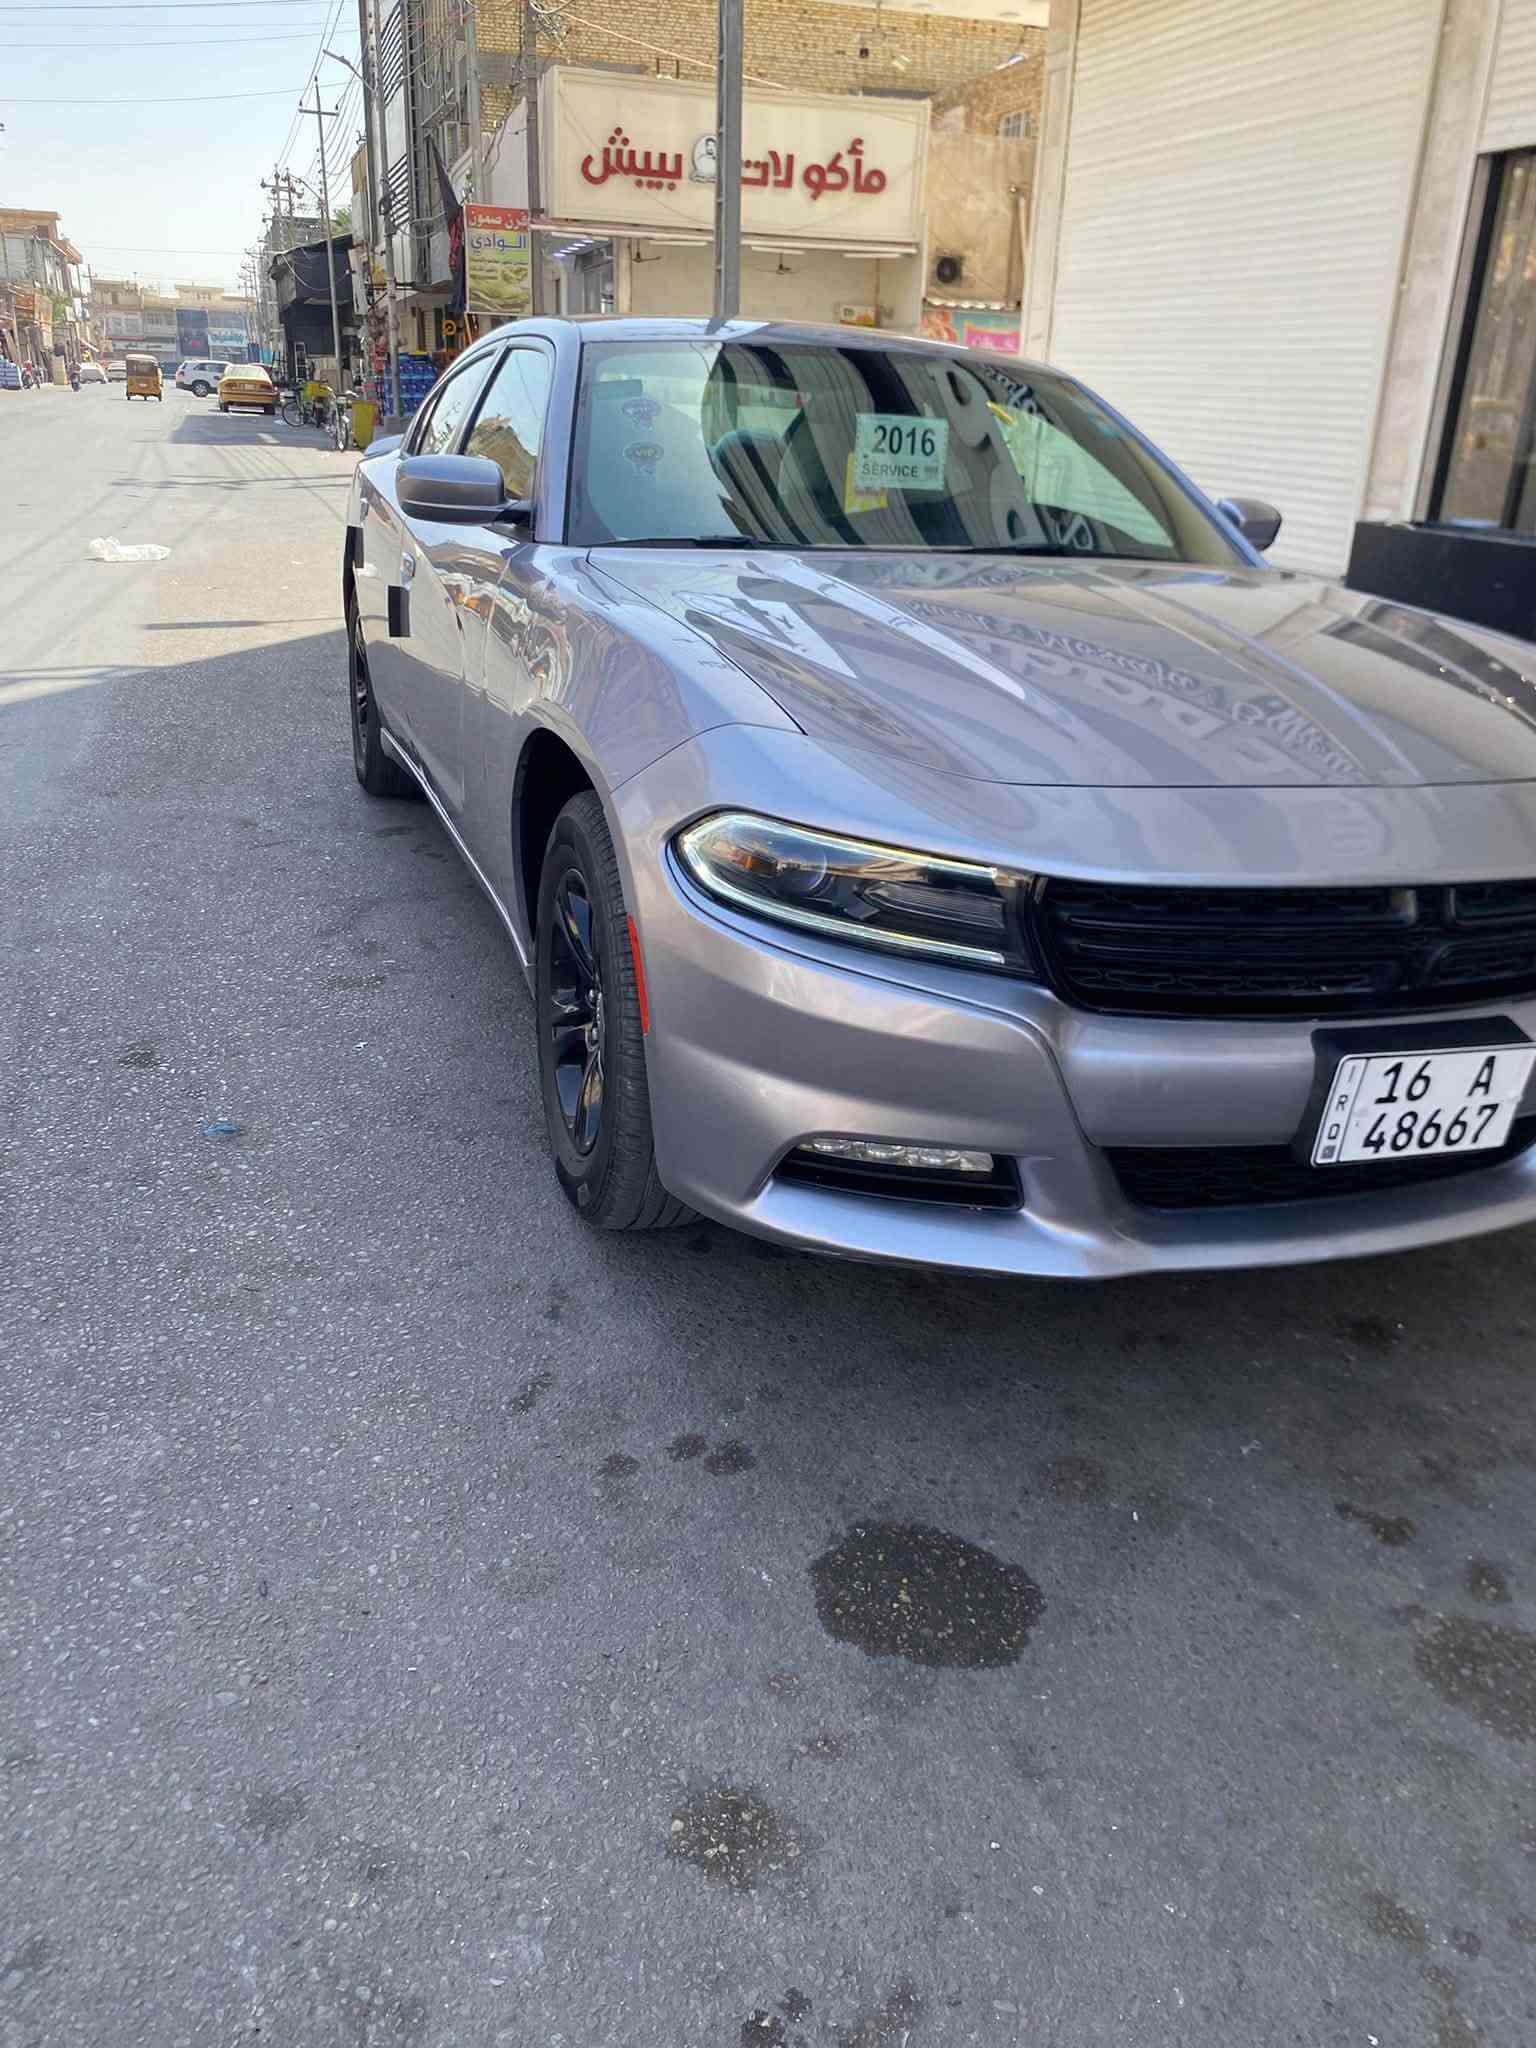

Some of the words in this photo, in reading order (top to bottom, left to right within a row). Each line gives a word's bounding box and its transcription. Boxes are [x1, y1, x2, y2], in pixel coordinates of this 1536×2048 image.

[471, 233, 526, 256] الوادي
[871, 425, 935, 456] 2016
[862, 463, 919, 478] SERVICE
[1374, 1059, 1431, 1104] 16
[1467, 1055, 1496, 1097] A
[1362, 1102, 1500, 1154] 48667
